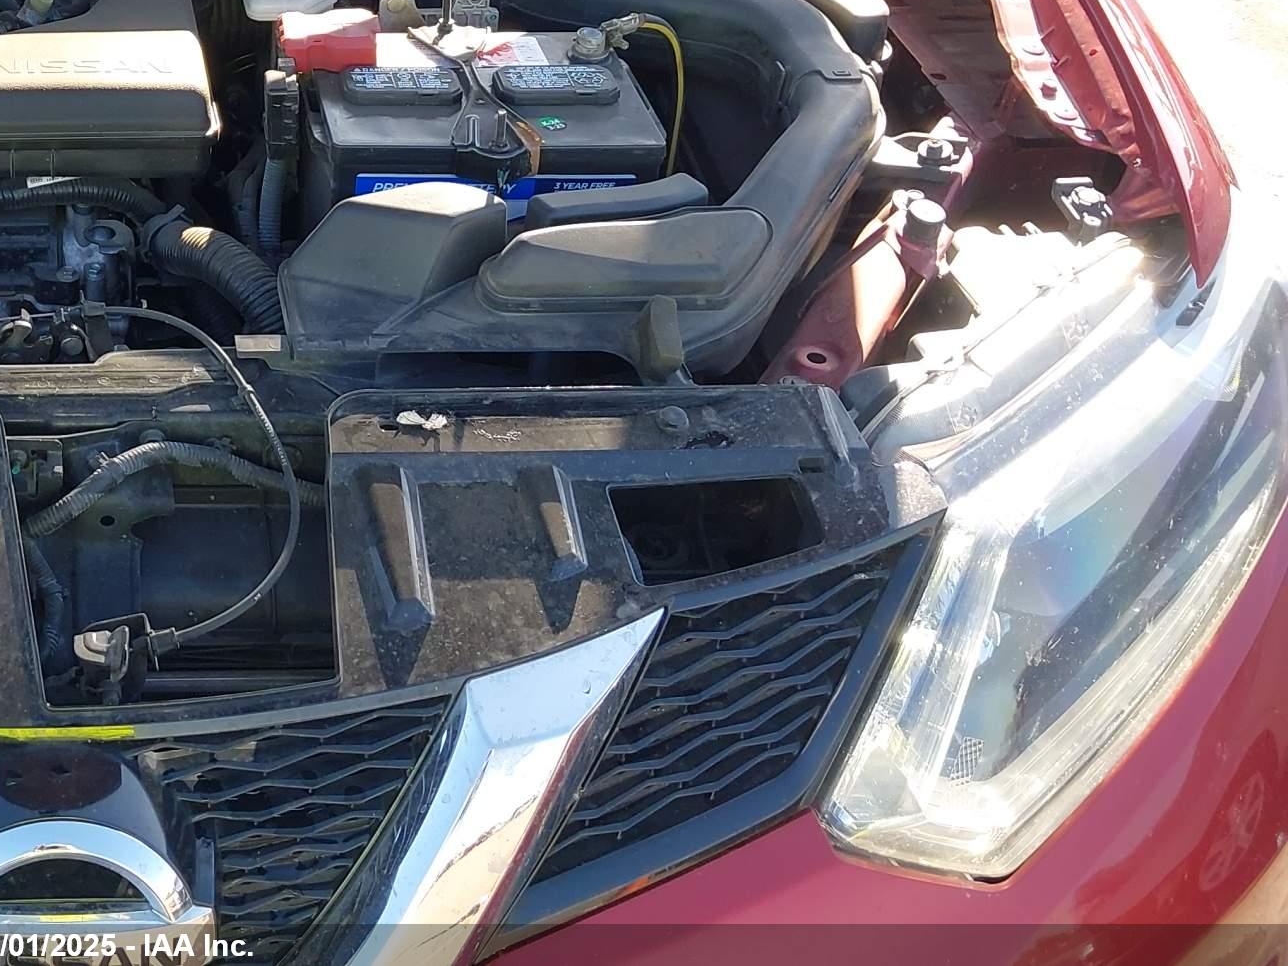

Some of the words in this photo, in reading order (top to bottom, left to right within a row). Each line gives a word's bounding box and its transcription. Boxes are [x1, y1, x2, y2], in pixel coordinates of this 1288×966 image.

[553, 181, 562, 191] 3
[563, 181, 589, 191] YEAR
[590, 180, 617, 190] FREE
